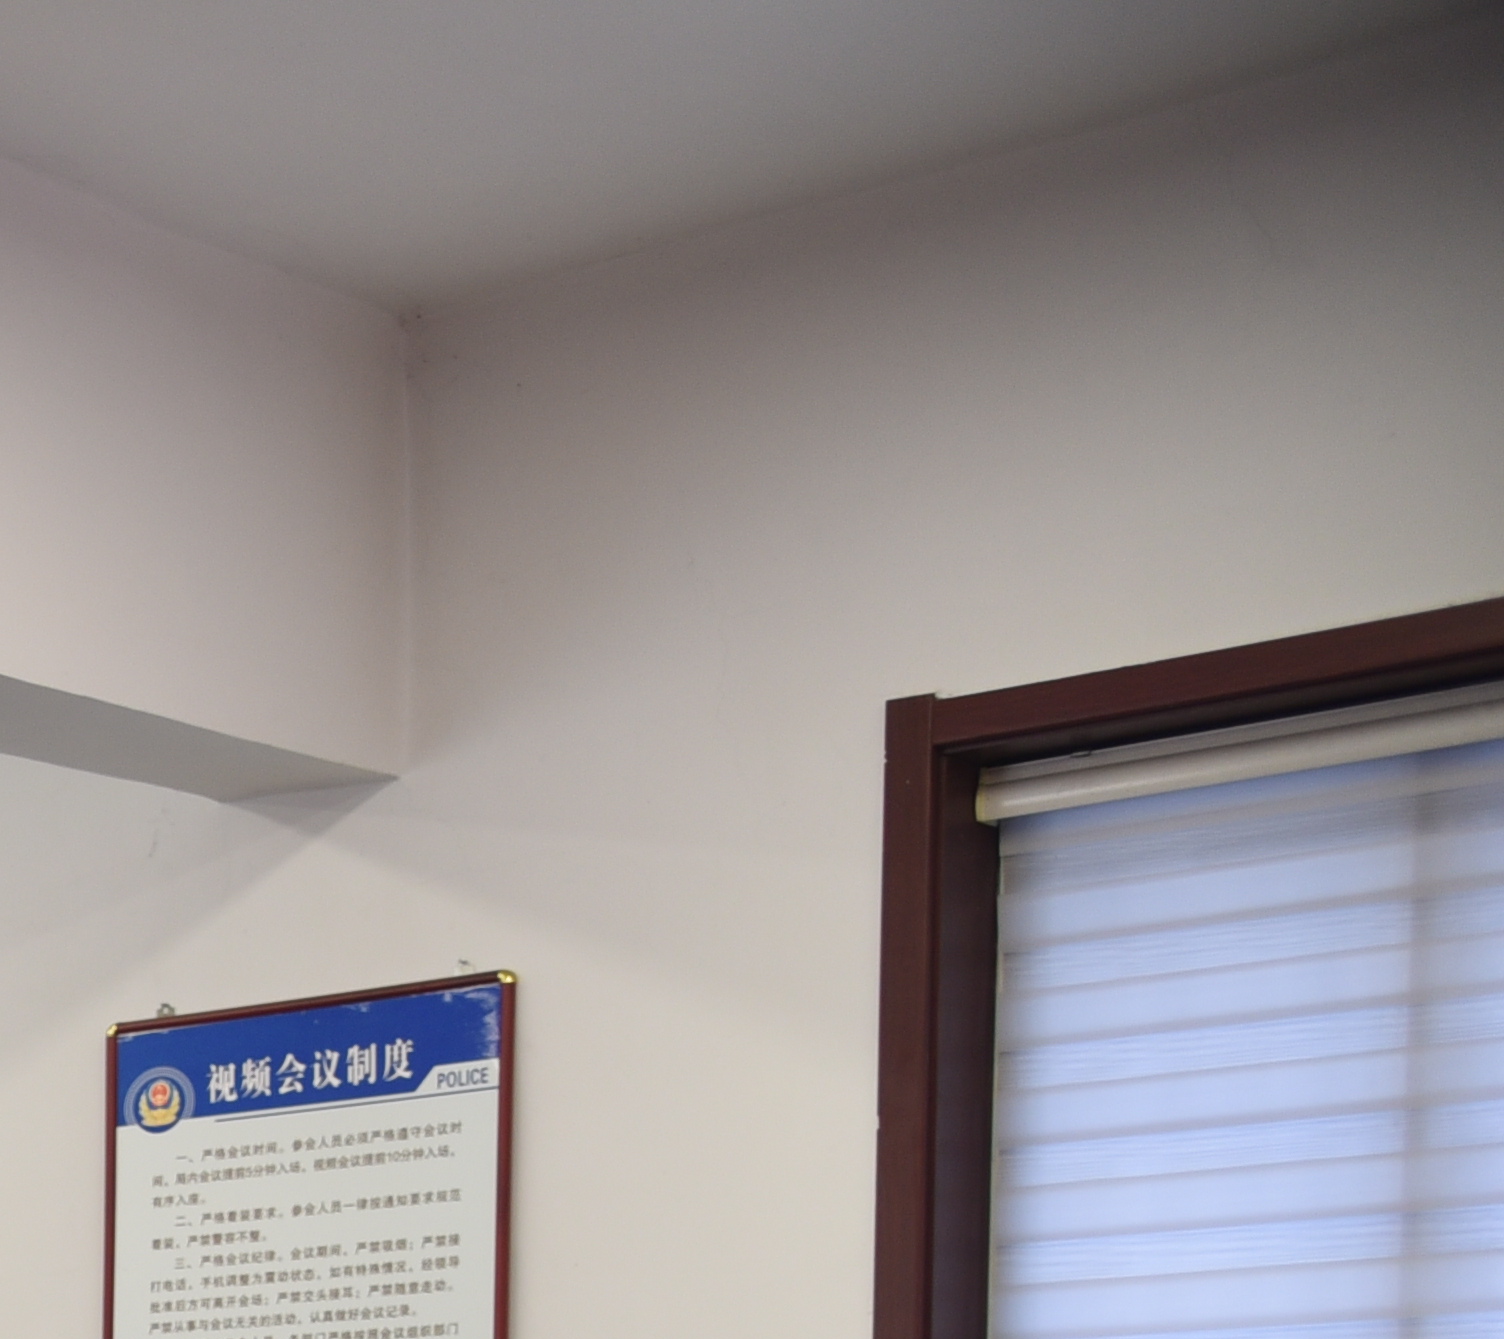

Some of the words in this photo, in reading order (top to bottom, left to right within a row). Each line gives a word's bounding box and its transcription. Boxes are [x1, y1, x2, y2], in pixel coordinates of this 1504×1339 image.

[206, 1037, 414, 1104] 视频会议制度
[436, 1067, 489, 1089] POLICE
